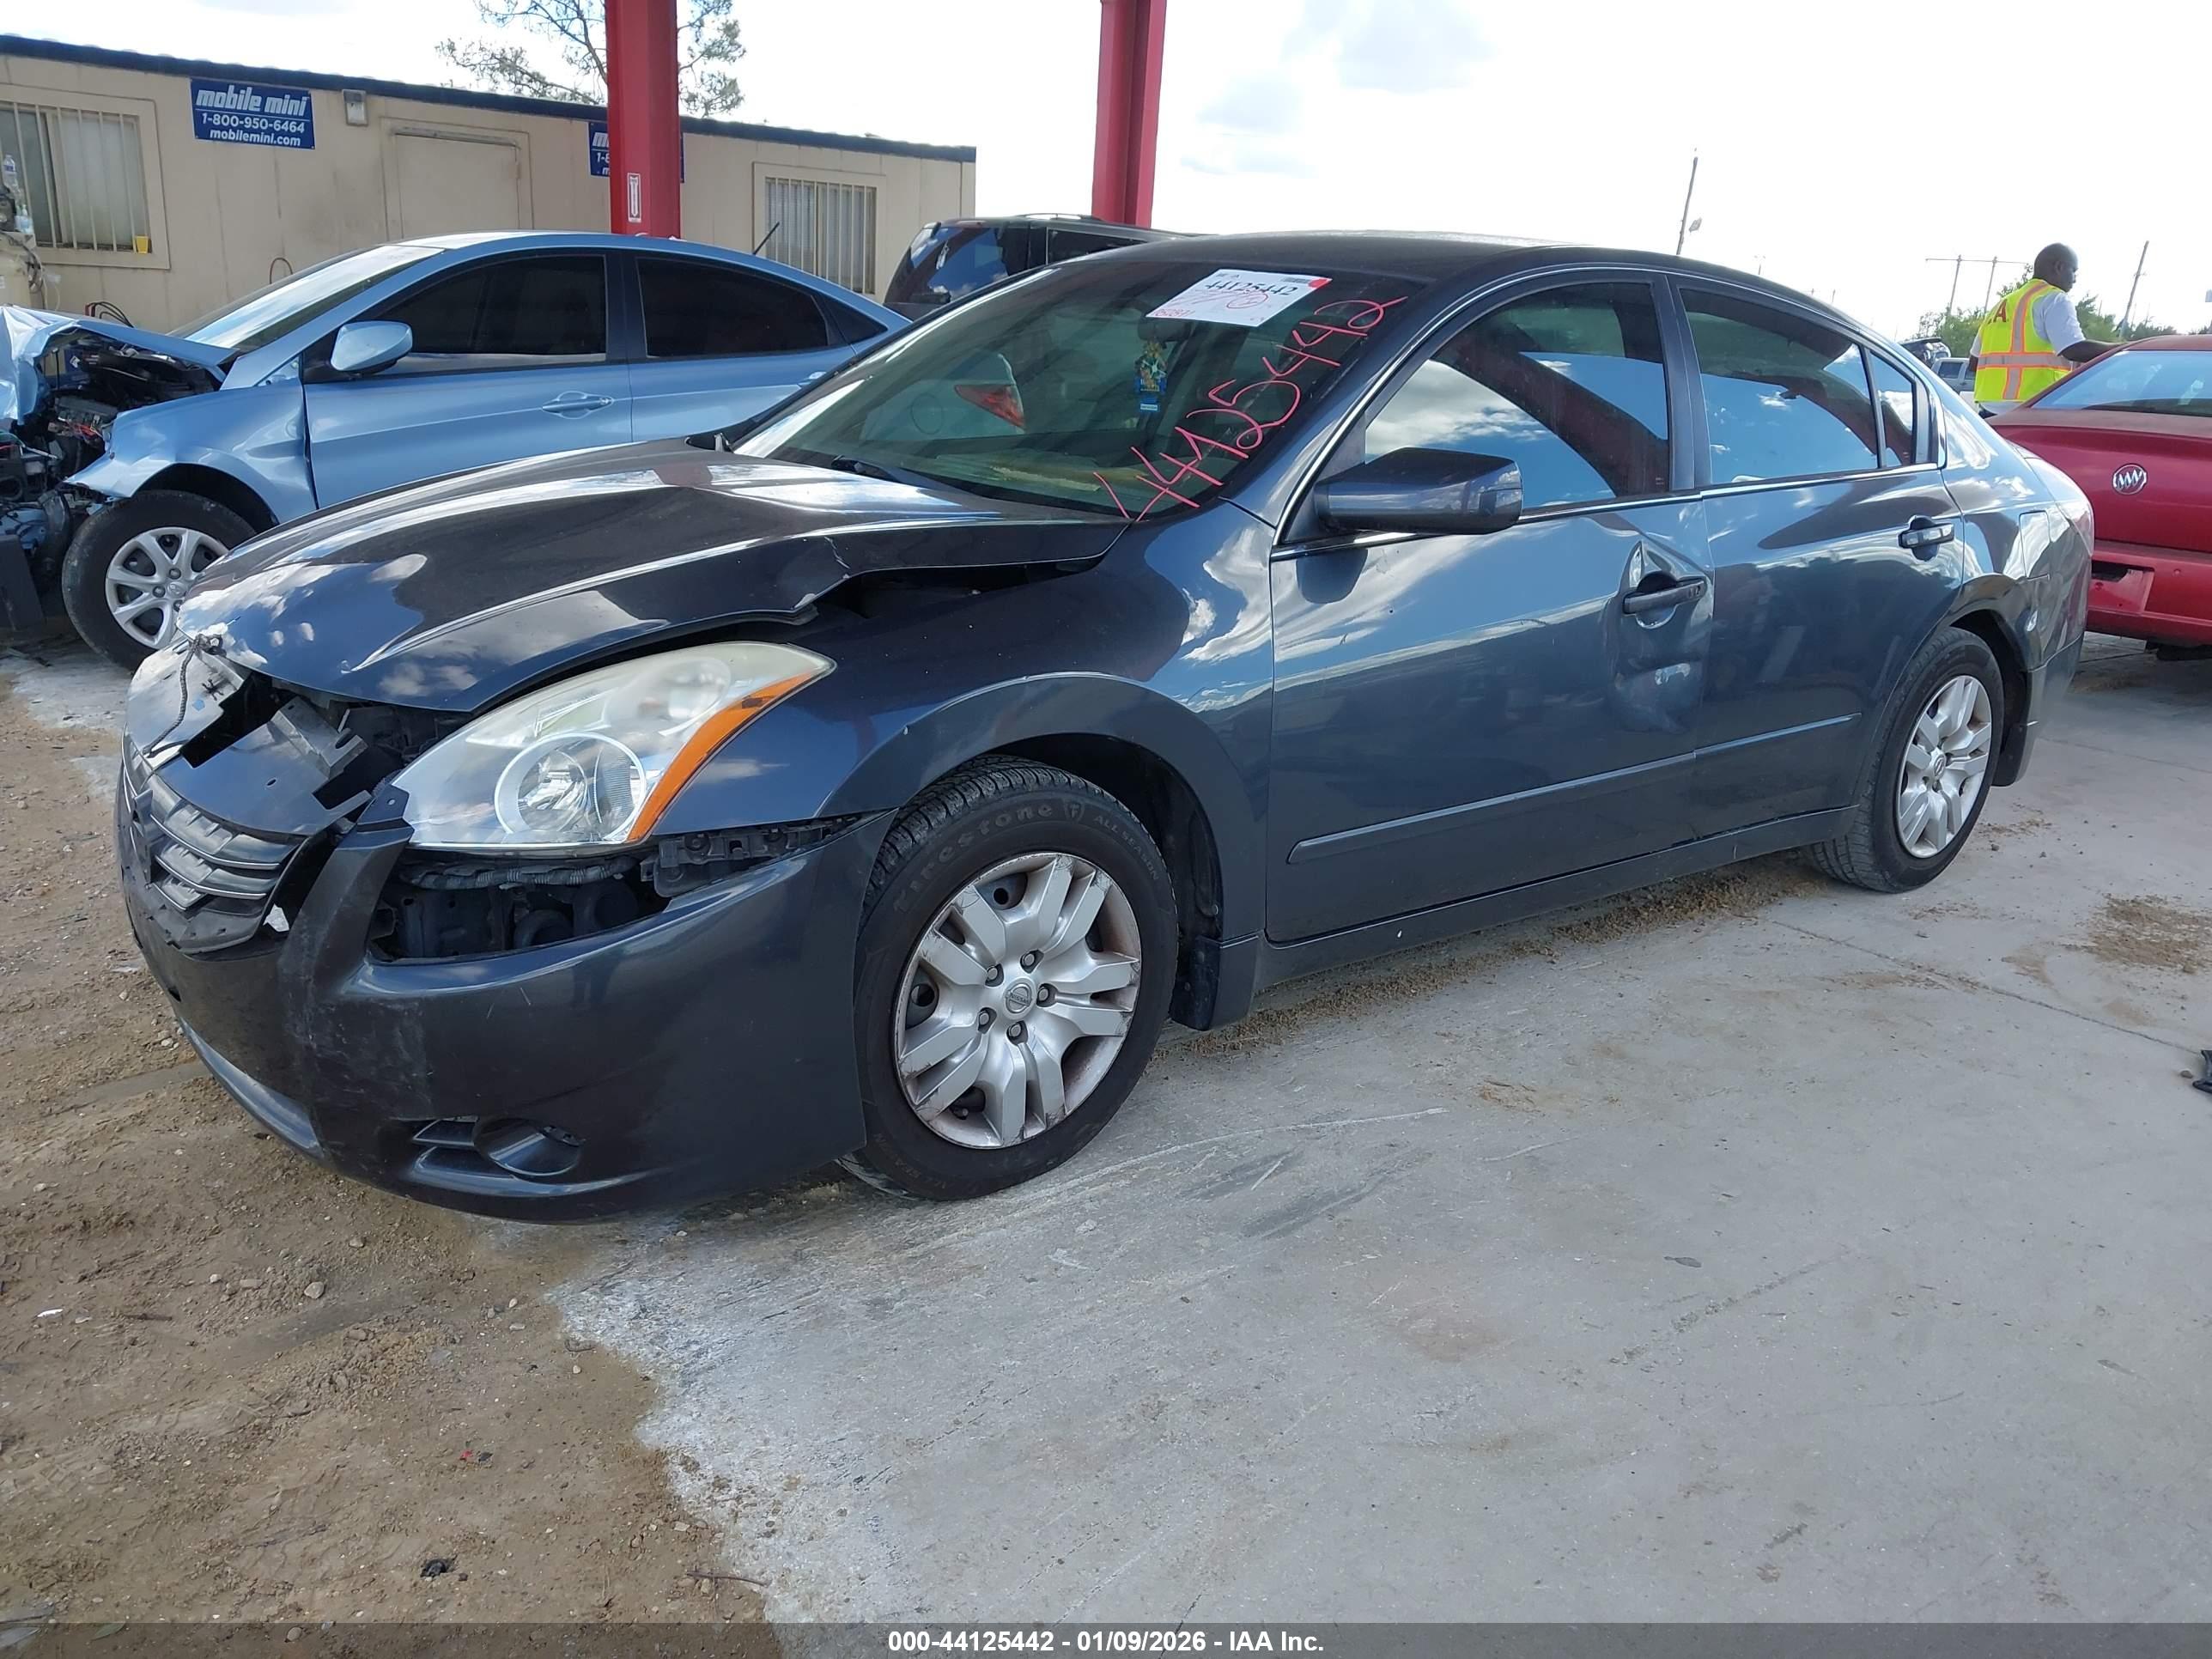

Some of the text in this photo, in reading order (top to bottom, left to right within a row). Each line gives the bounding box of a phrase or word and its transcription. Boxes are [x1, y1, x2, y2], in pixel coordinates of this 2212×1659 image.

[196, 85, 307, 116] mobile mini
[202, 112, 305, 133] 1-800-950-6464
[210, 129, 301, 147] mobilemini.com
[1205, 281, 1298, 296] 44125442
